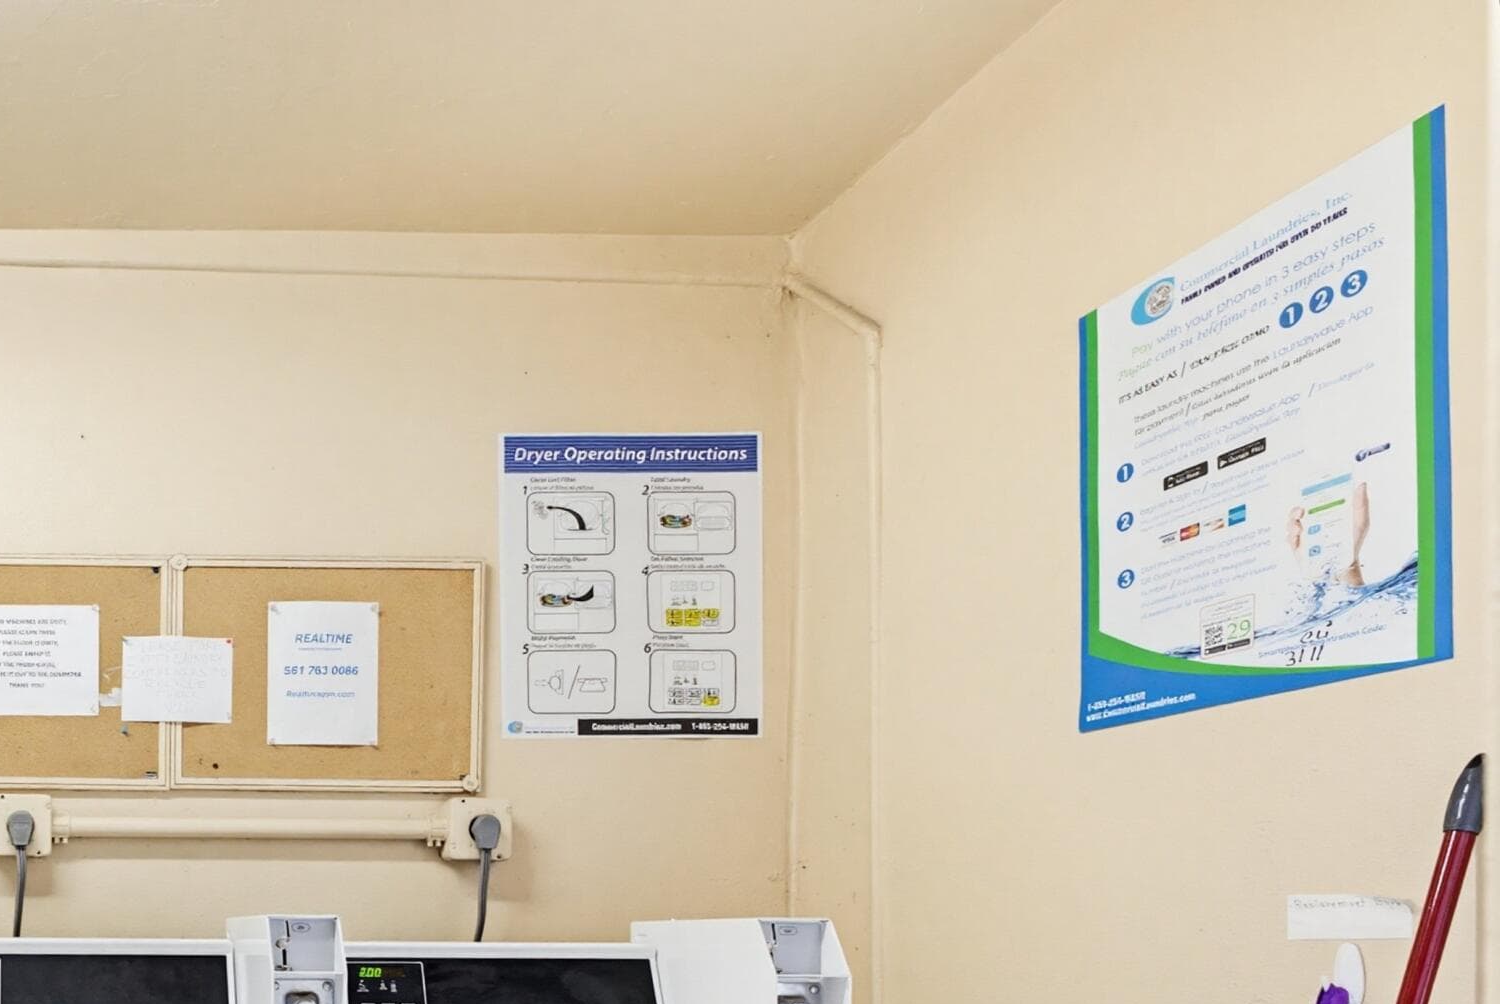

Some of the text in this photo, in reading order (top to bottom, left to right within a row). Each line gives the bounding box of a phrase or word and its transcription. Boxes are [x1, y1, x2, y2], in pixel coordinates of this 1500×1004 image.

[1185, 309, 1214, 329] your
[1216, 283, 1262, 314] phone
[1265, 274, 1278, 288] in
[1282, 266, 1291, 279] 3
[1293, 246, 1329, 271] easy
[1332, 222, 1377, 252] steps
[514, 446, 748, 464] Dryer Operating Instructions
[294, 632, 354, 644] REALTIME
[1227, 619, 1251, 641] 29
[283, 665, 304, 676] 561
[331, 665, 359, 676] 0086
